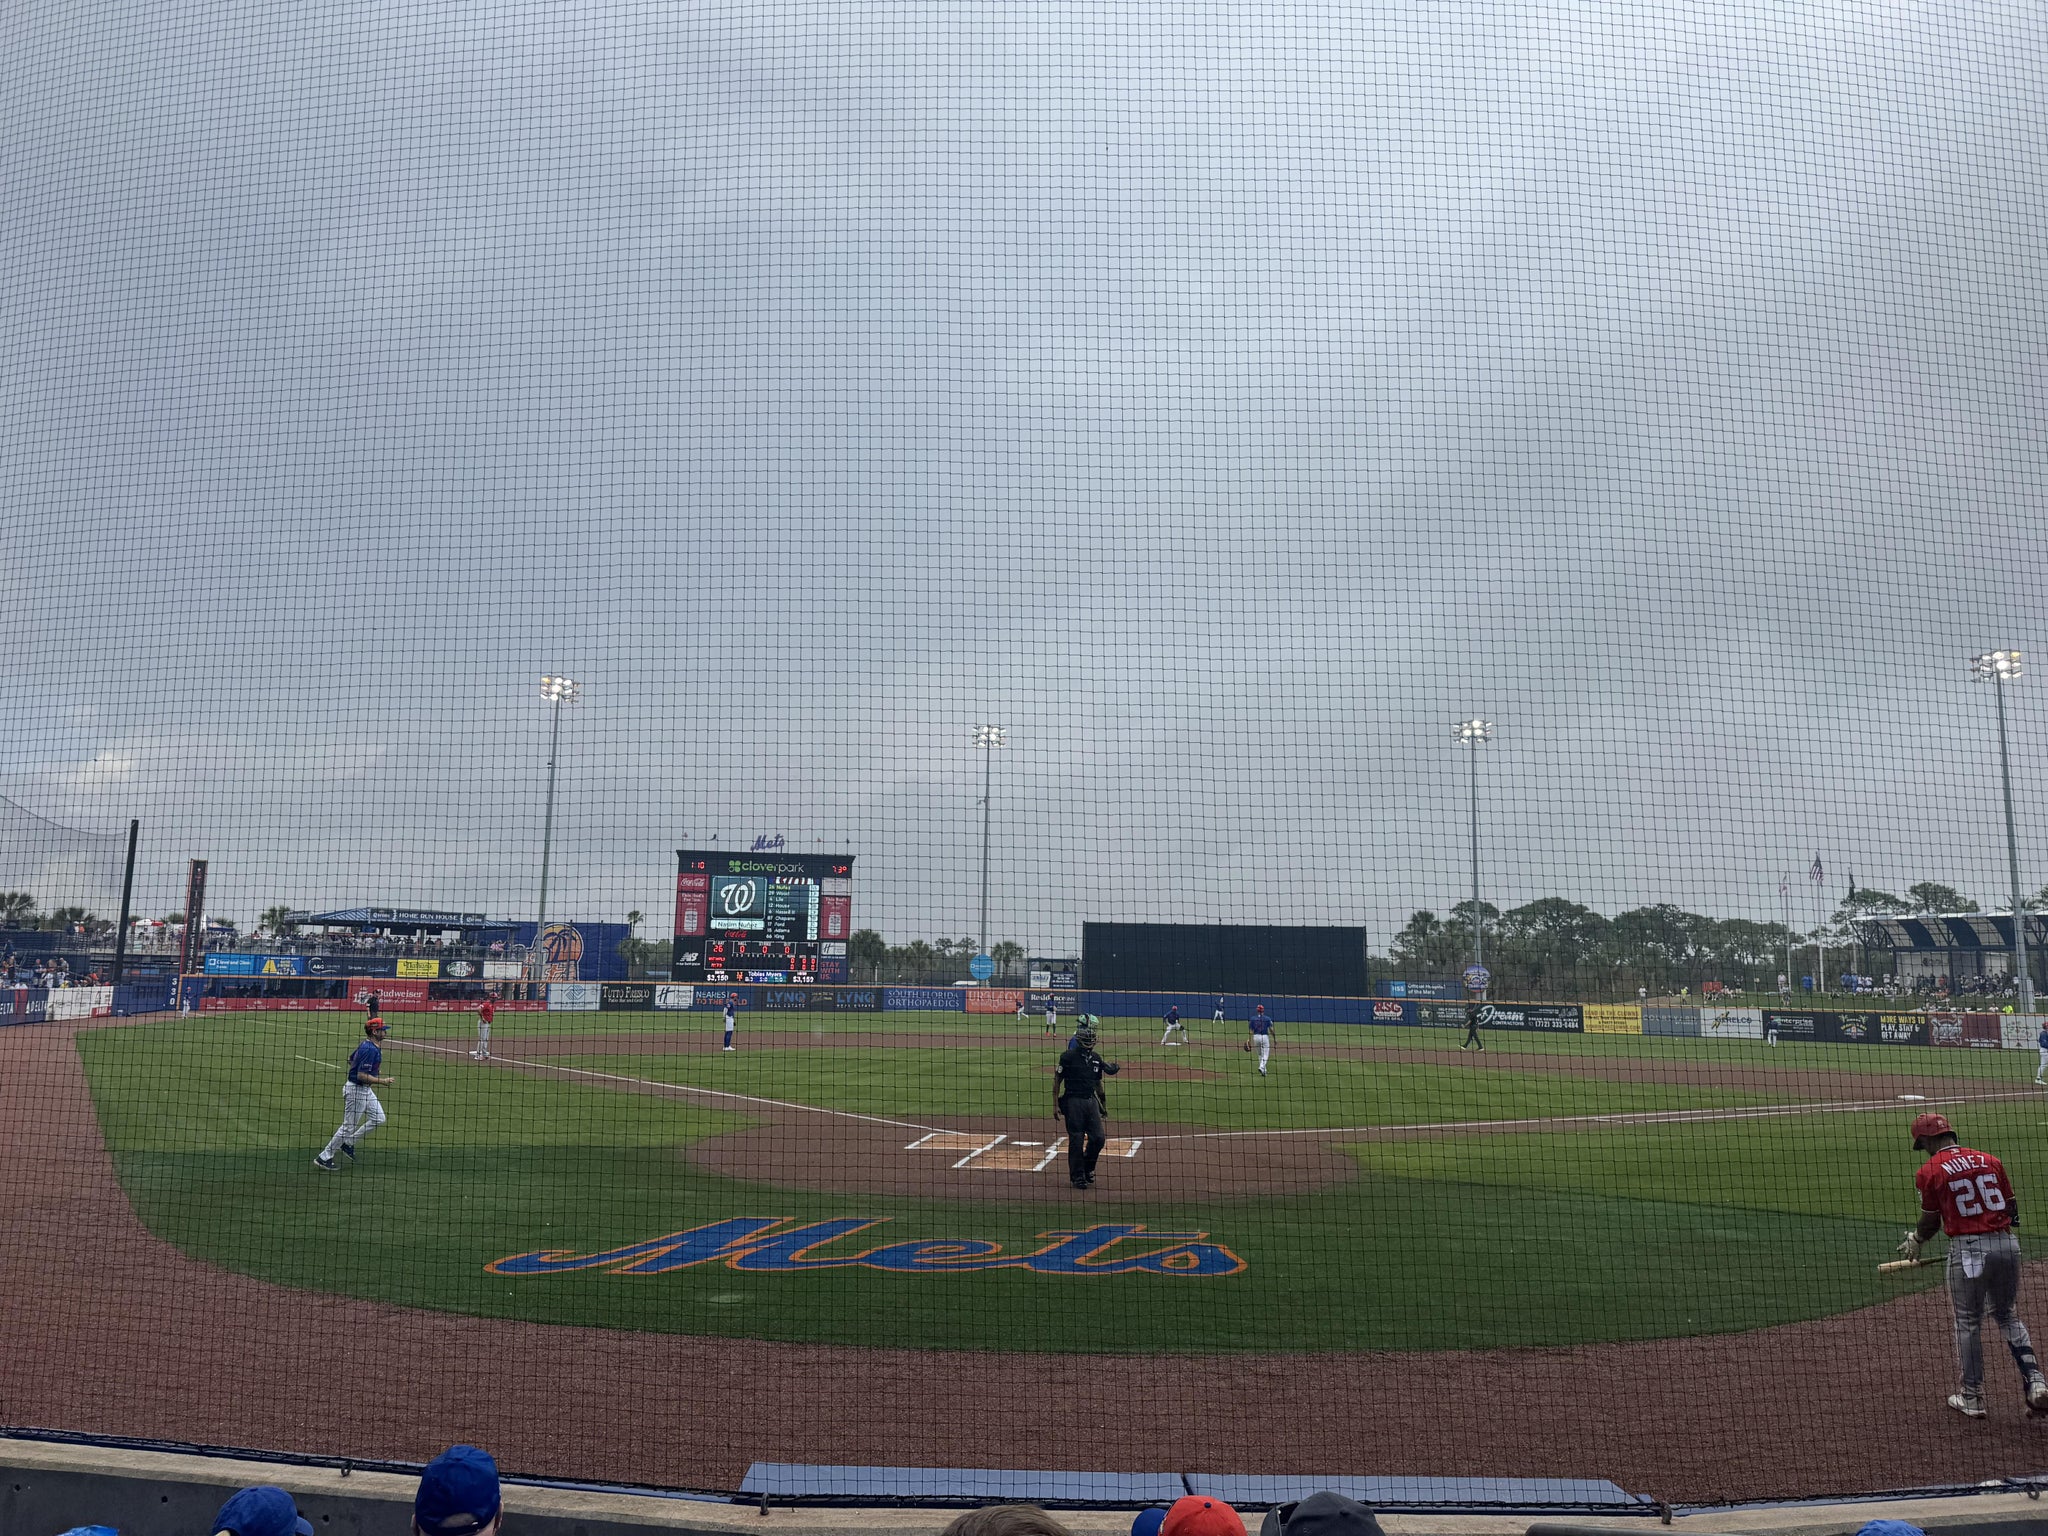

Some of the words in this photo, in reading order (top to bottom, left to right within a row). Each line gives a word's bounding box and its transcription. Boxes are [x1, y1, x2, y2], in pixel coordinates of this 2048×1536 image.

[750, 834, 784, 851] Mets
[785, 946, 790, 954] 0
[377, 989, 423, 998] Budweiser
[602, 986, 624, 998] TUTTO
[626, 986, 650, 998] FRESCO
[889, 990, 919, 998] SOUTH
[888, 998, 959, 1007] ORTHOPAEDICS
[1375, 1002, 1401, 1012] RSG
[0, 1003, 13, 1014] ELTA
[1476, 1005, 1524, 1025] Dream
[1880, 1016, 1897, 1024] MORE
[1898, 1016, 1917, 1025] WAYS
[1918, 1017, 1925, 1025] TO
[1881, 1024, 1897, 1033] PLAY,
[1881, 1032, 1892, 1040] GET
[1948, 1174, 2005, 1217] 26
[483, 1215, 1248, 1277] Mets
